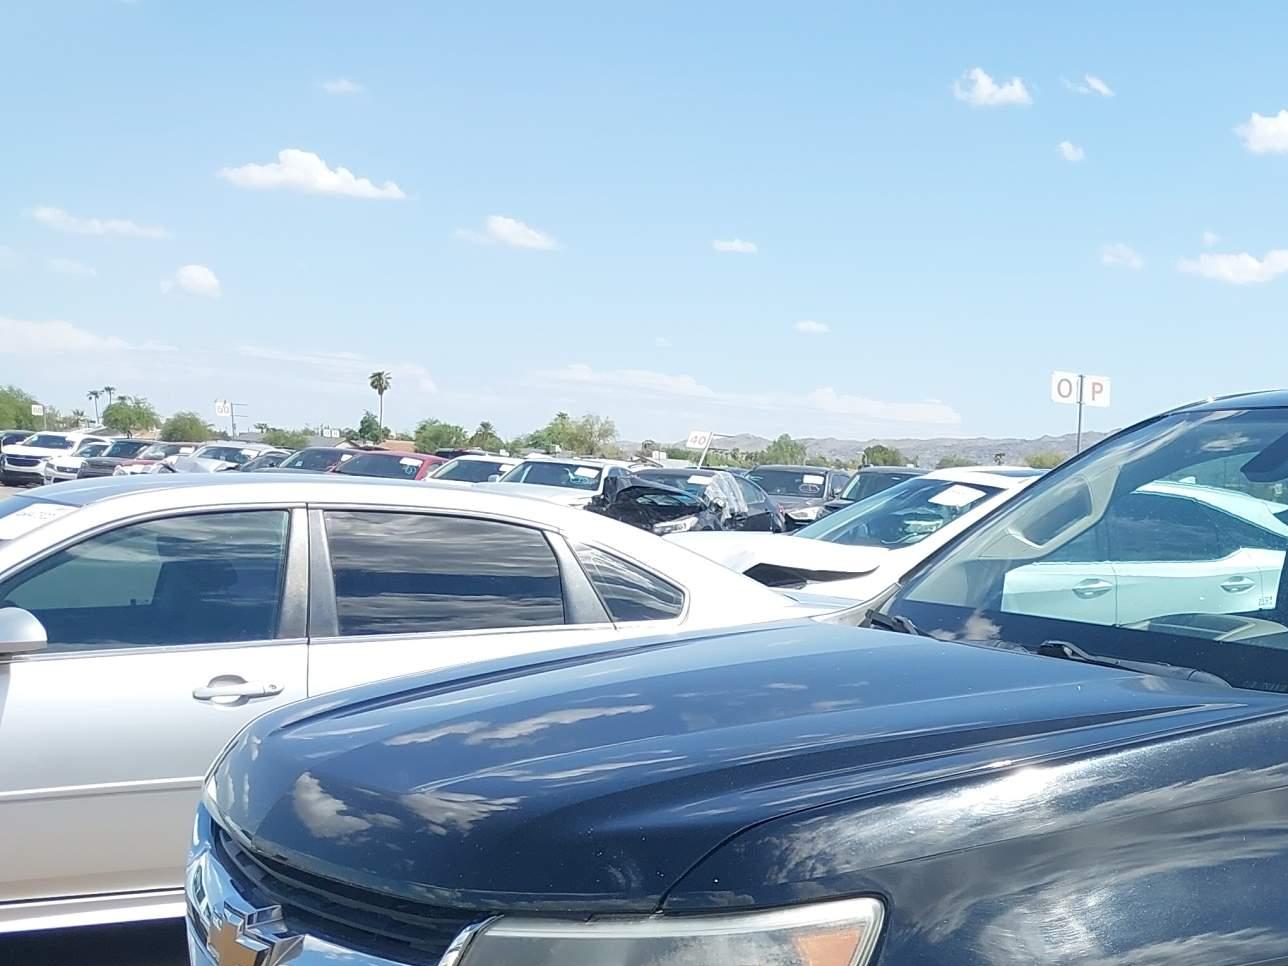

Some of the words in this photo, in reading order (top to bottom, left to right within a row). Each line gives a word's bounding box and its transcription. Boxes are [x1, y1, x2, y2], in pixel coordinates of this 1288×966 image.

[1056, 378, 1073, 399] O
[1091, 381, 1104, 401] P
[689, 435, 707, 446] 40
